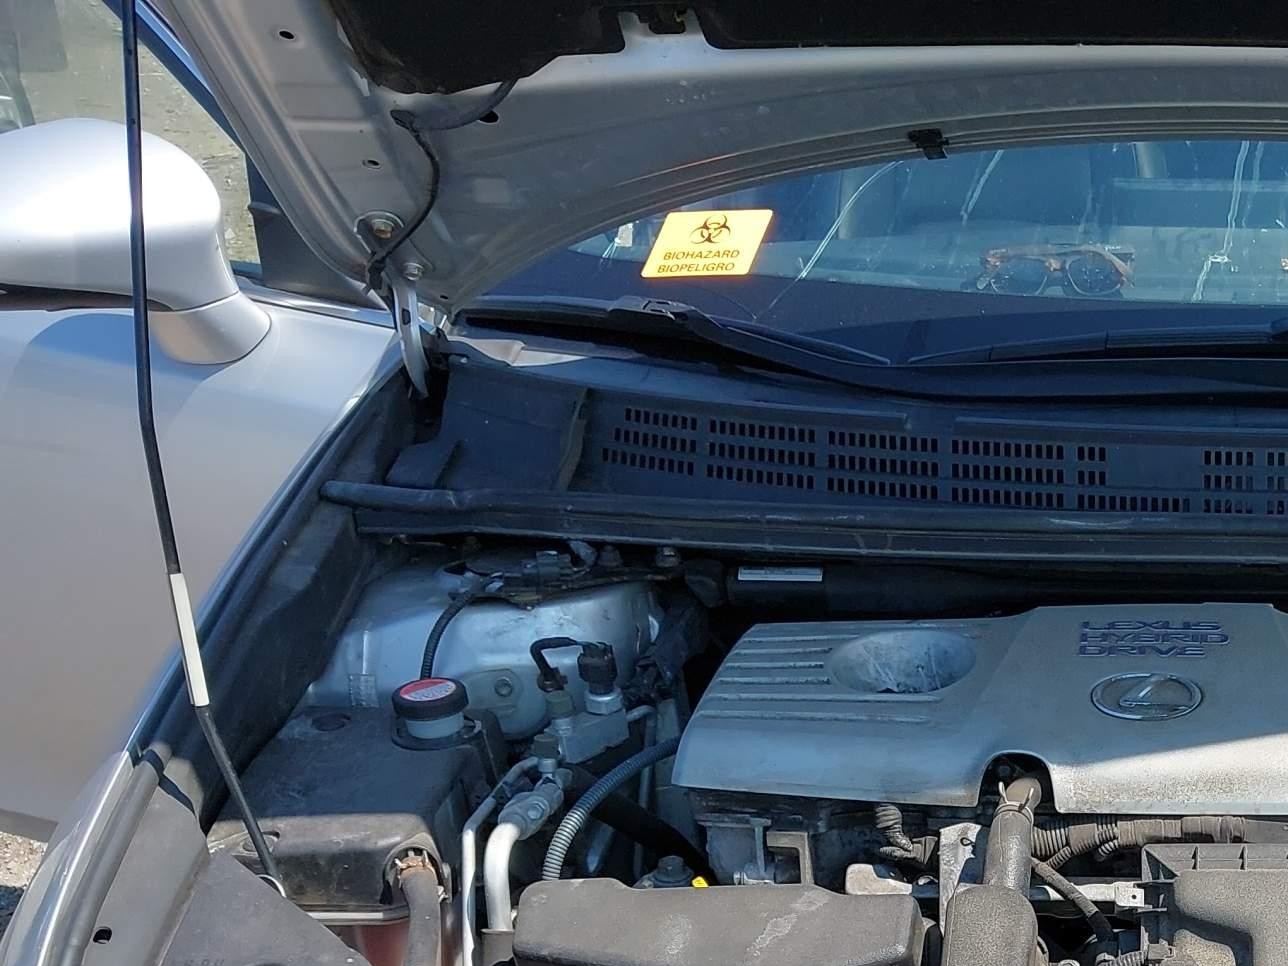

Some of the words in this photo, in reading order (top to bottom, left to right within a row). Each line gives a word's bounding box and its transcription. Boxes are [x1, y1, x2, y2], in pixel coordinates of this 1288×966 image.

[663, 249, 740, 261] BIOHAZARD
[657, 262, 735, 273] BIOPELIGRO
[1080, 620, 1222, 631] LEXUS
[1079, 632, 1229, 645] HYBRID
[1078, 645, 1206, 657] DRIVE
